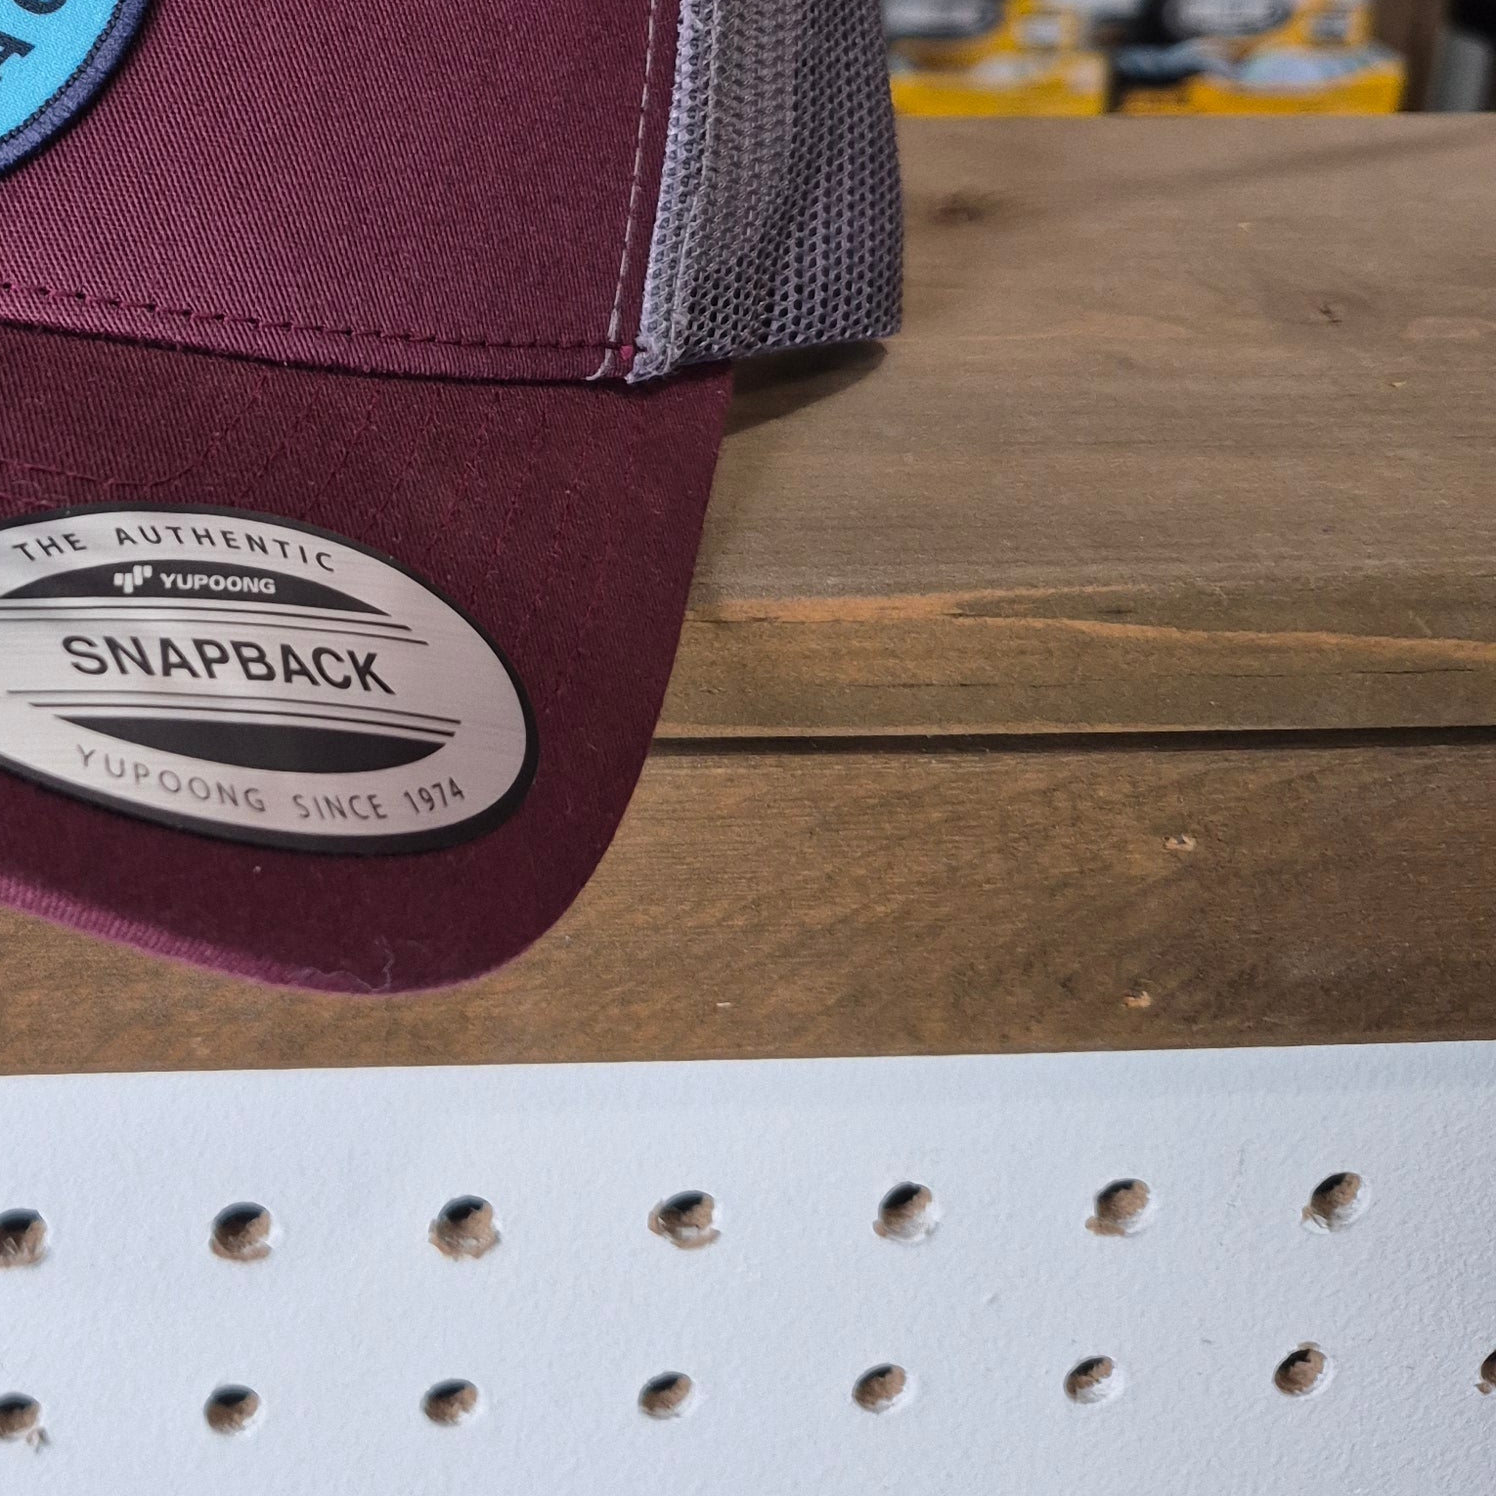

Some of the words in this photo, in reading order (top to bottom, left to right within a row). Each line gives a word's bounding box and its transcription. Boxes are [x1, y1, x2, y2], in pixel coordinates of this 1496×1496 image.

[13, 532, 88, 564] THE
[114, 525, 337, 573] AUTHENTIC
[160, 572, 277, 595] YUPOONG
[61, 634, 397, 696] SNAPBACK
[76, 744, 266, 813] YUPOONG
[292, 793, 389, 822] SINCE
[403, 776, 466, 815] 1974
